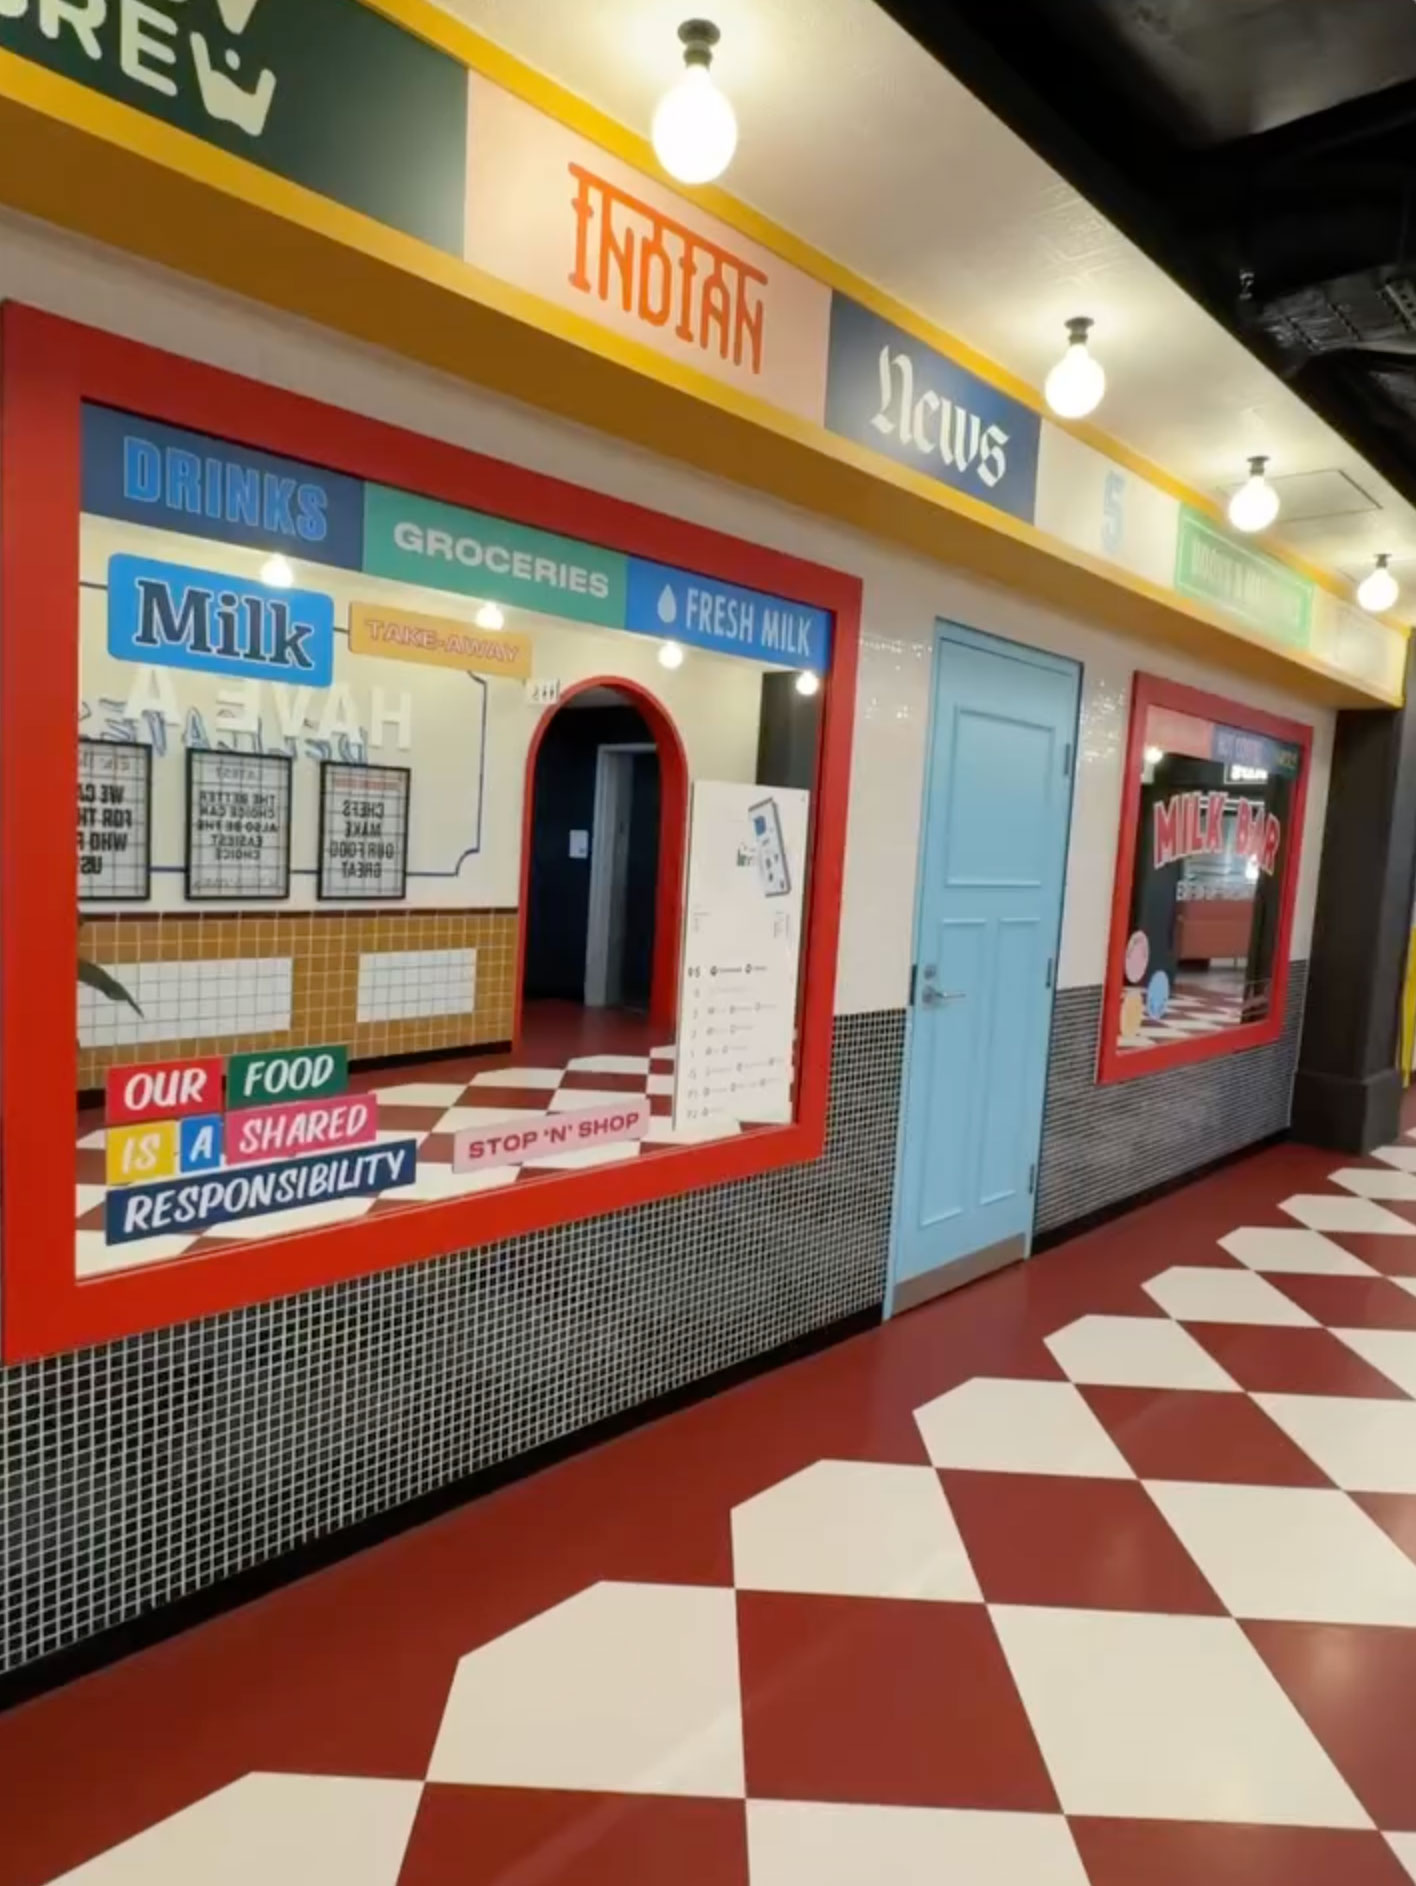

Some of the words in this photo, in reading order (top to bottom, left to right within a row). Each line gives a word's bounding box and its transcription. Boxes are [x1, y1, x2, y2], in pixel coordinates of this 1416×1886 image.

[0, 0, 276, 136] REW
[568, 162, 768, 374] INDIAN
[870, 344, 1010, 488] News
[123, 435, 328, 541] DRINKS
[393, 522, 609, 599] GROCERIES
[132, 577, 315, 669] Milk
[365, 619, 520, 662] TAKE-AWAY
[685, 587, 753, 643] FRESH
[761, 604, 812, 658] MILK
[1153, 791, 1228, 869] MILK
[1236, 796, 1280, 877] BAR
[125, 1067, 207, 1111] OUR
[243, 1054, 334, 1097] FOOD
[122, 1135, 158, 1174] IS
[188, 1125, 212, 1163] A
[239, 1103, 367, 1155] SHARED
[468, 1130, 538, 1160] STOP
[577, 1111, 640, 1139] SHOP
[123, 1149, 405, 1235] RESPONSIBILITY
